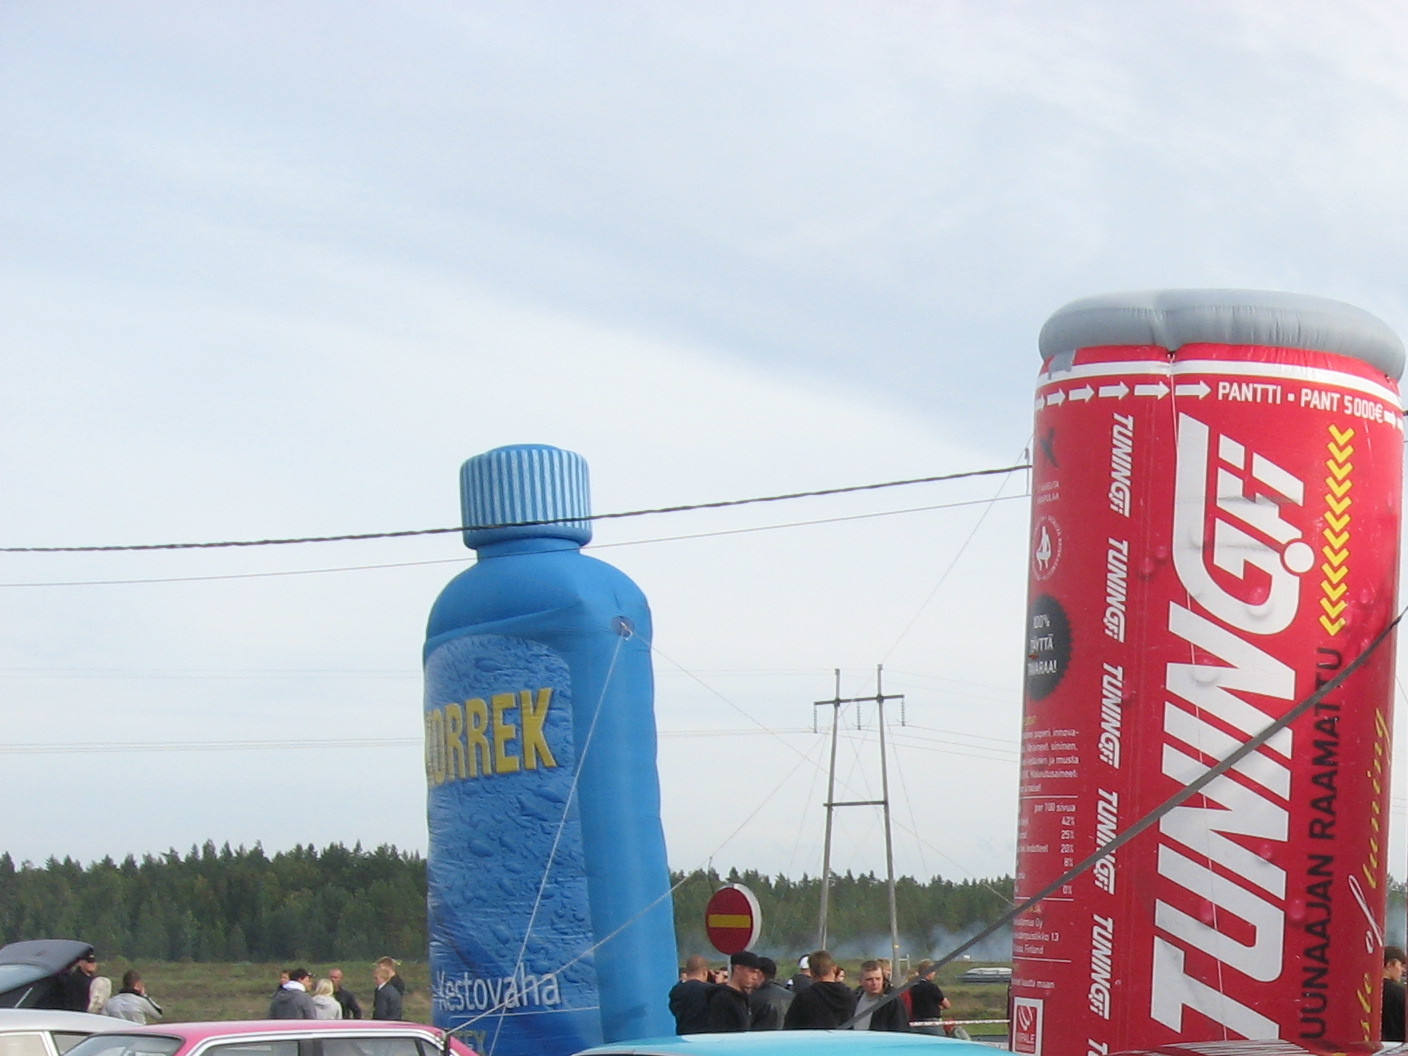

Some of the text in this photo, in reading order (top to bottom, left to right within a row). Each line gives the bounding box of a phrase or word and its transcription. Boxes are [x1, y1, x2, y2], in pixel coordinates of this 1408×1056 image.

[1218, 381, 1385, 423] PANTTI PANT 5000€
[1301, 854, 1336, 1040] UUNAAJAN
